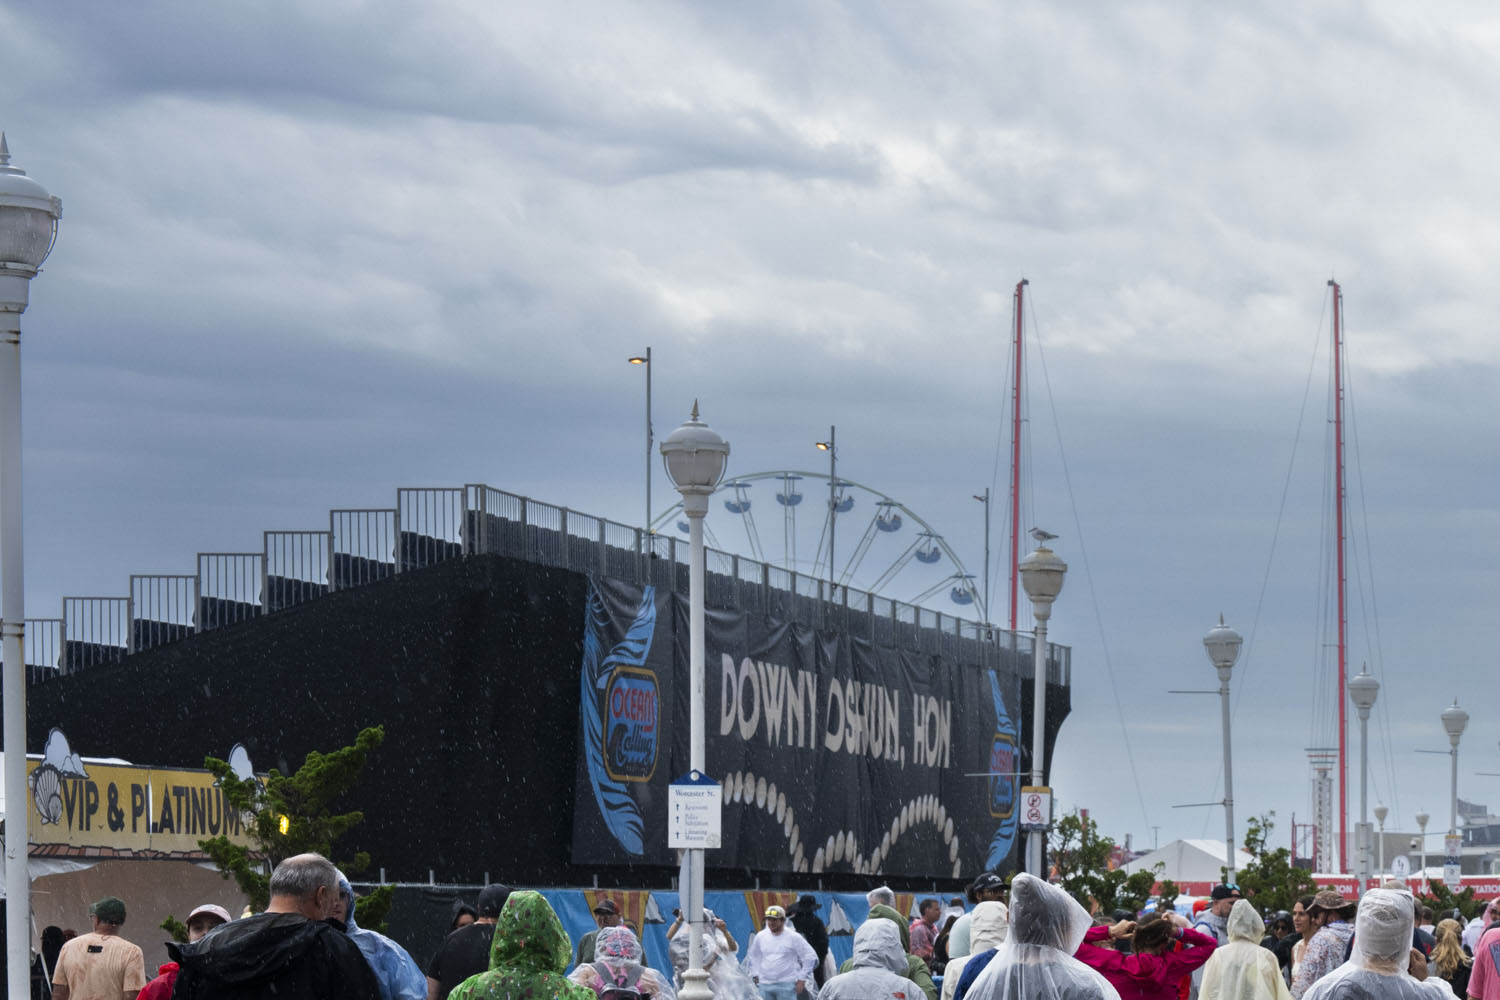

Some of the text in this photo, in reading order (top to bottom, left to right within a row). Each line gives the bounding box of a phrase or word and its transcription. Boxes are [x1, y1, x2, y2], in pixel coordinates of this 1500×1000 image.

[720, 652, 818, 750] DOWNY
[912, 692, 951, 769] HON
[62, 779, 240, 837] VIP & PLATINUM
